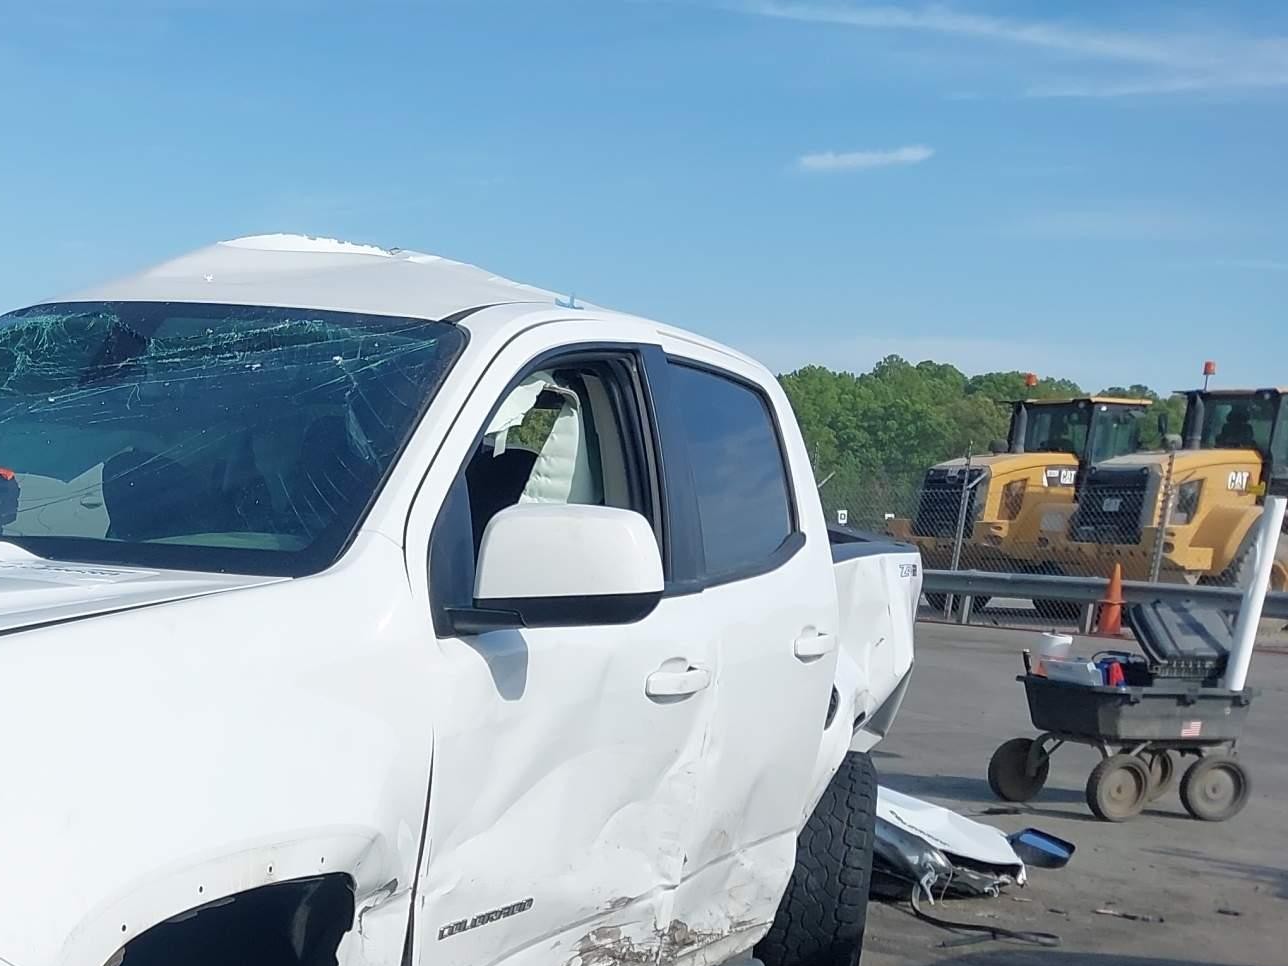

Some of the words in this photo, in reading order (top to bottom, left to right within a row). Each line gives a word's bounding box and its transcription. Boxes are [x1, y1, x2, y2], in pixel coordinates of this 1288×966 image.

[1061, 470, 1077, 484] CAT
[1228, 471, 1249, 491] CAT
[438, 898, 533, 940] COLORADO
